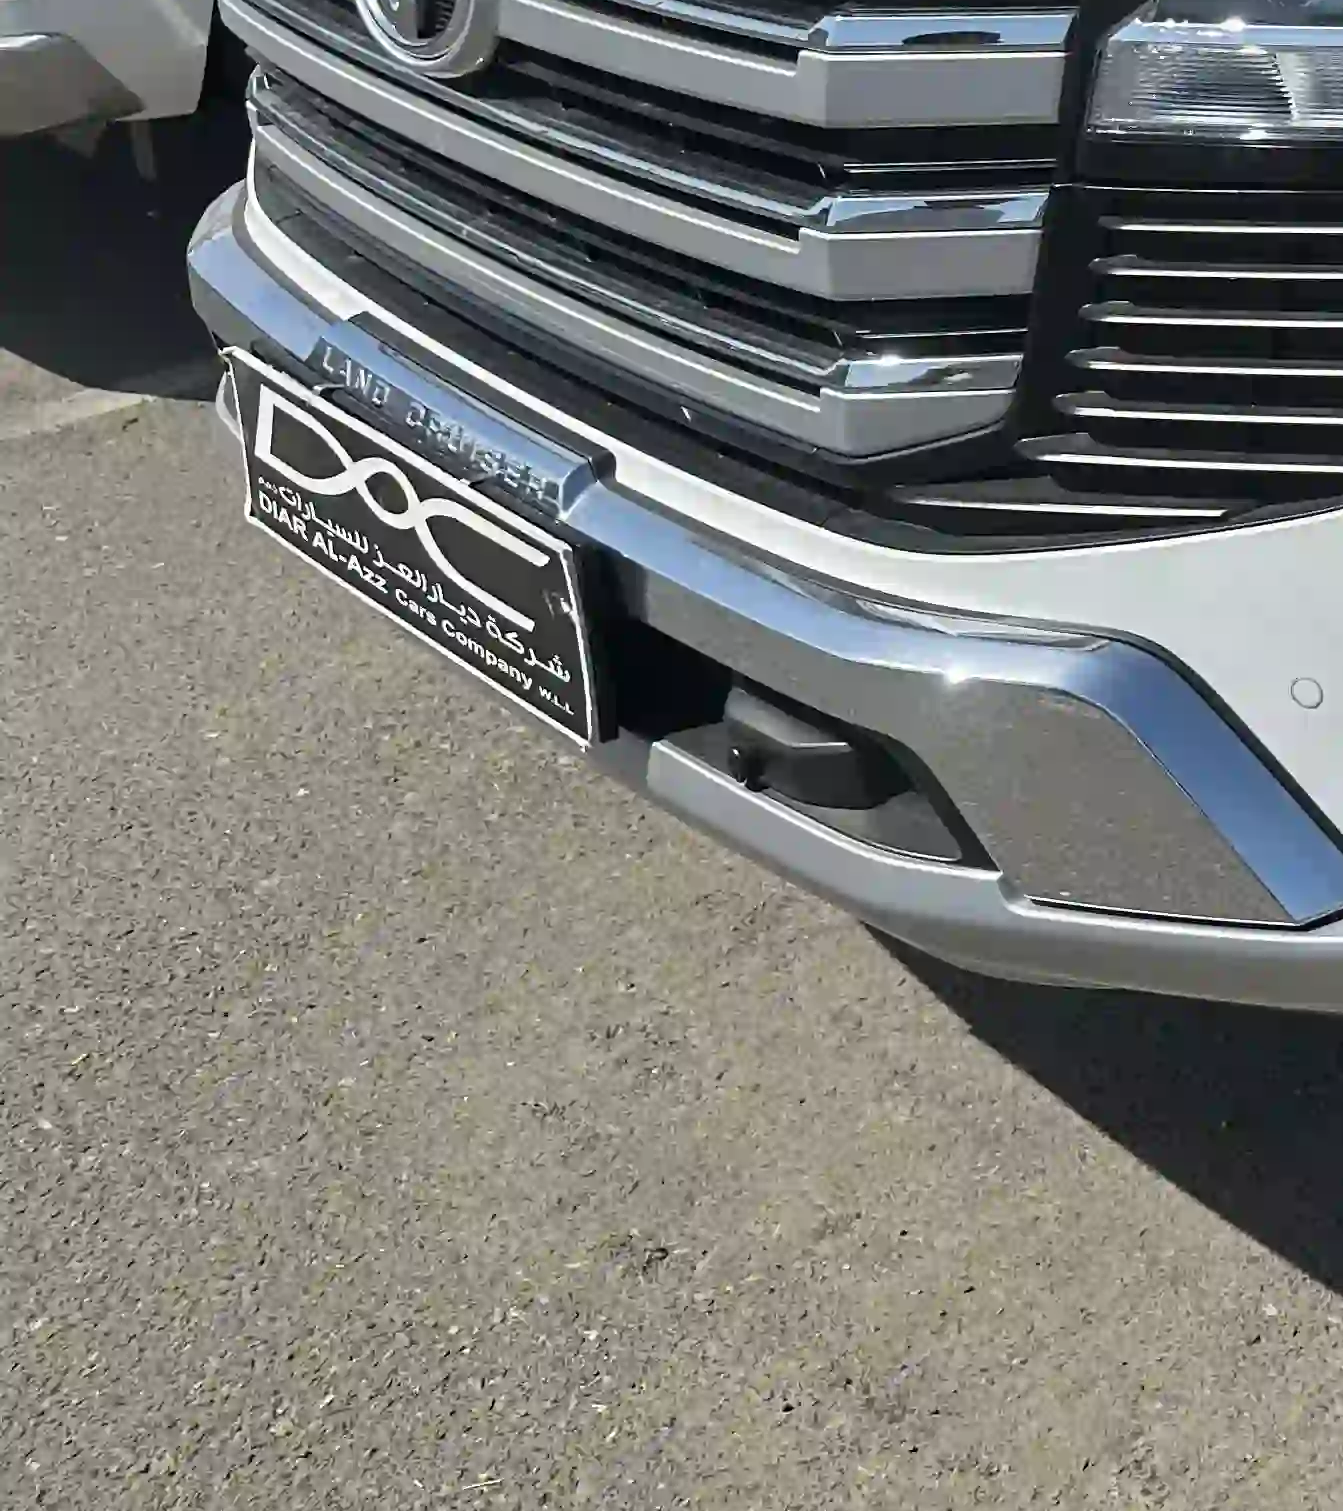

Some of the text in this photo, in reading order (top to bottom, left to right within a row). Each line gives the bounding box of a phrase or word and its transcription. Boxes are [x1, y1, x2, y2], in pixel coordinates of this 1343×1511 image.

[320, 346, 391, 407] LAND
[258, 489, 309, 541] DIAR
[394, 587, 437, 626] Cars
[440, 618, 533, 690] Company
